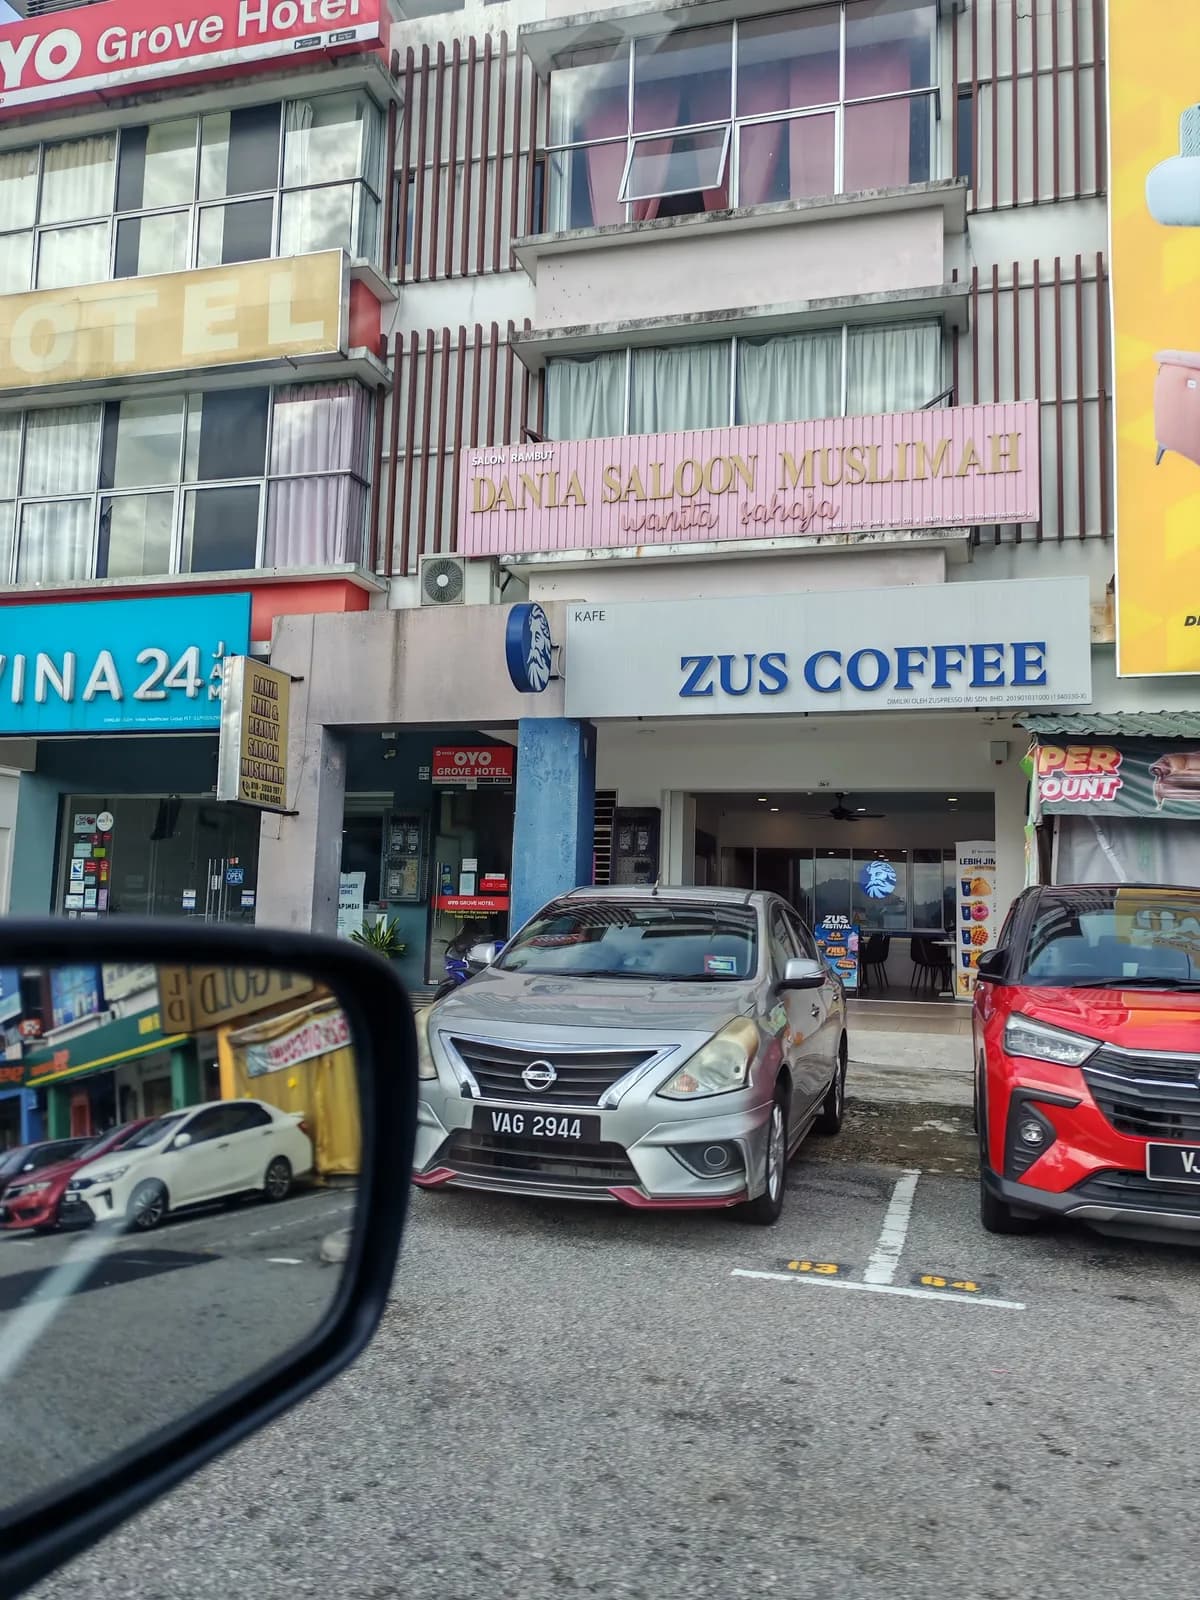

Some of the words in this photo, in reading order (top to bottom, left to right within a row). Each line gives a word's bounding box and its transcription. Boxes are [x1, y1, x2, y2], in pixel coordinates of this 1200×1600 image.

[97, 14, 224, 64] Grove
[9, 271, 325, 374] OTEL
[472, 456, 505, 466] SALON
[511, 451, 554, 463] RAMBUT
[471, 470, 587, 513] DANIA
[603, 454, 758, 503] SALOON
[779, 431, 1022, 491] MUSLIMAH
[621, 500, 719, 531] wanita
[740, 493, 839, 532] sahaja
[574, 610, 606, 621] KAFE
[0, 650, 124, 703] INA
[133, 646, 204, 701] 24
[679, 652, 788, 697] ZUS
[804, 641, 1047, 693] COFFEE
[253, 674, 279, 700] DANIA
[251, 694, 271, 718] HAIR
[272, 704, 279, 721] &
[248, 715, 280, 741] BEAUTY
[247, 737, 280, 762] SALOON
[454, 752, 492, 766] OYO
[1037, 745, 1122, 776] PER
[240, 757, 285, 784] MUSLIMAH
[437, 768, 472, 776] GROVE
[474, 768, 508, 776] HOTEL
[1039, 777, 1123, 802] OUNT
[226, 870, 244, 881] OPEN
[823, 914, 848, 924] ZUS
[491, 1111, 525, 1134] VAG
[532, 1117, 582, 1140] 2944
[787, 1260, 840, 1274] 63
[920, 1274, 980, 1292] 64
